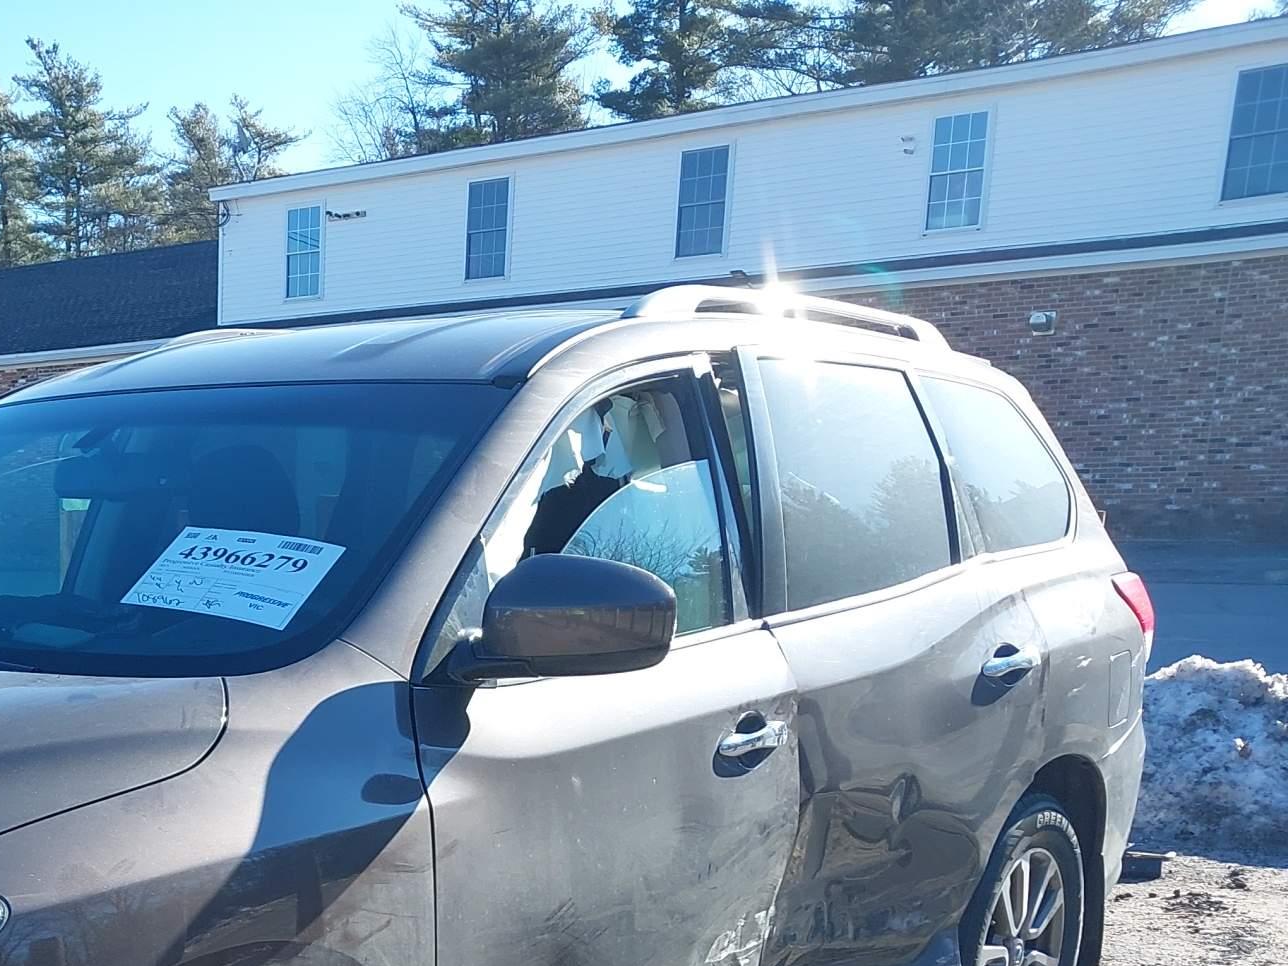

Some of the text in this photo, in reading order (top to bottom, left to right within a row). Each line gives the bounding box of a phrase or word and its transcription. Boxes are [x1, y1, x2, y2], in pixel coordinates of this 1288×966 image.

[179, 545, 309, 573] 43966279
[234, 591, 293, 609] PROGRESSIVE
[1037, 810, 1069, 831] GREEN
